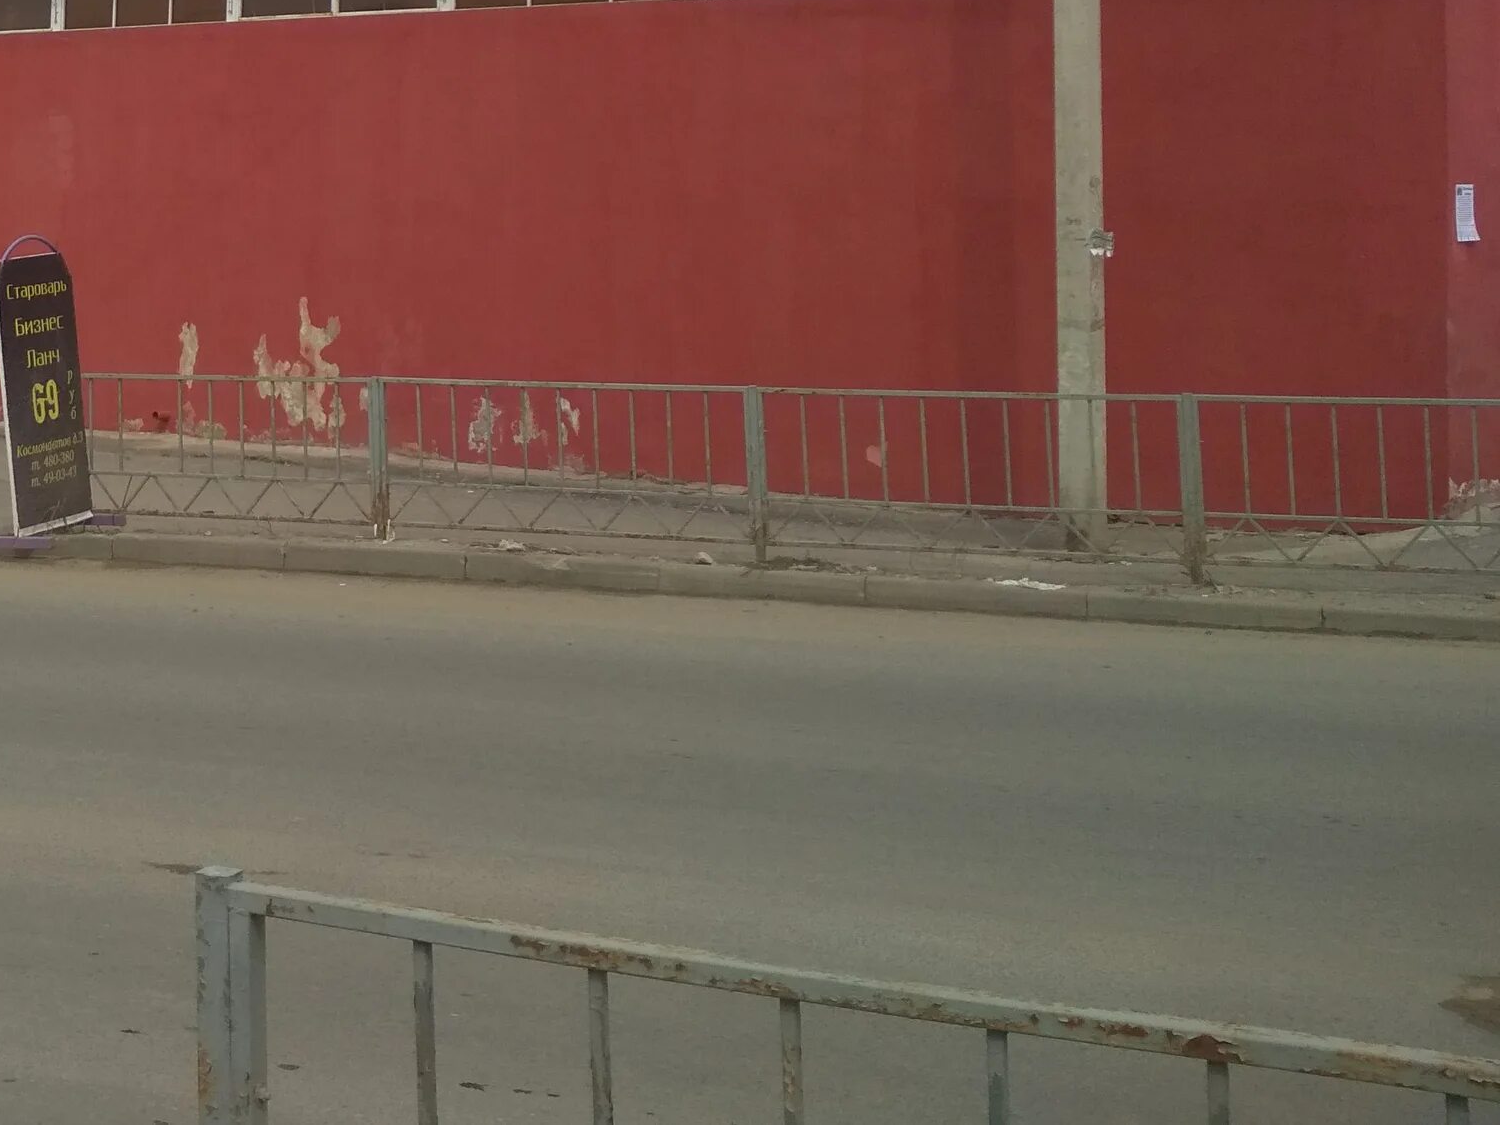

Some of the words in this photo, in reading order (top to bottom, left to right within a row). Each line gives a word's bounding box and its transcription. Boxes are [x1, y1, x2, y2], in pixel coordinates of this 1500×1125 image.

[6, 279, 67, 301] Староварь
[15, 315, 64, 337] Бизнес
[26, 348, 60, 369] Ланч
[32, 379, 60, 424] 69
